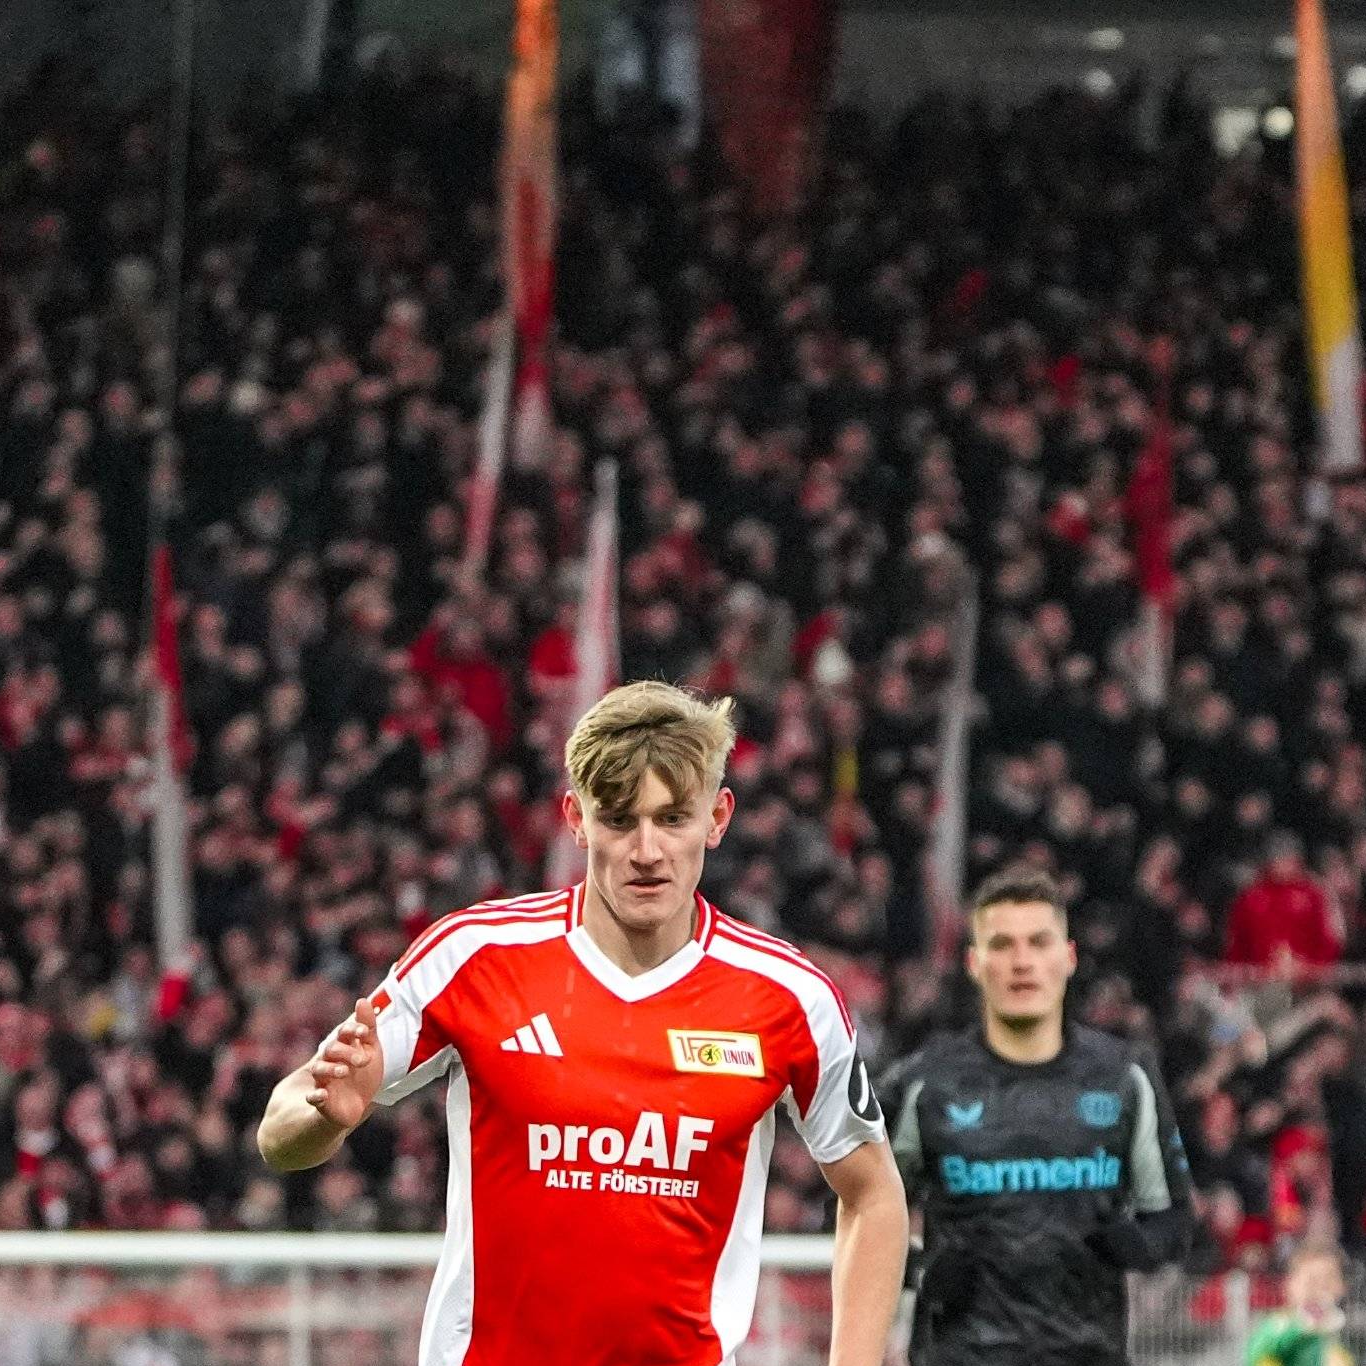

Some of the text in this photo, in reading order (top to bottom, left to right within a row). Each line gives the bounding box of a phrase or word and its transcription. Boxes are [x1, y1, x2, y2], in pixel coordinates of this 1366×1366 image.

[722, 1049, 756, 1067] UNION
[527, 1110, 715, 1172] proAF
[545, 1168, 700, 1198] ALTE FÖRSTEREI
[941, 1146, 1122, 1195] Barmenia
